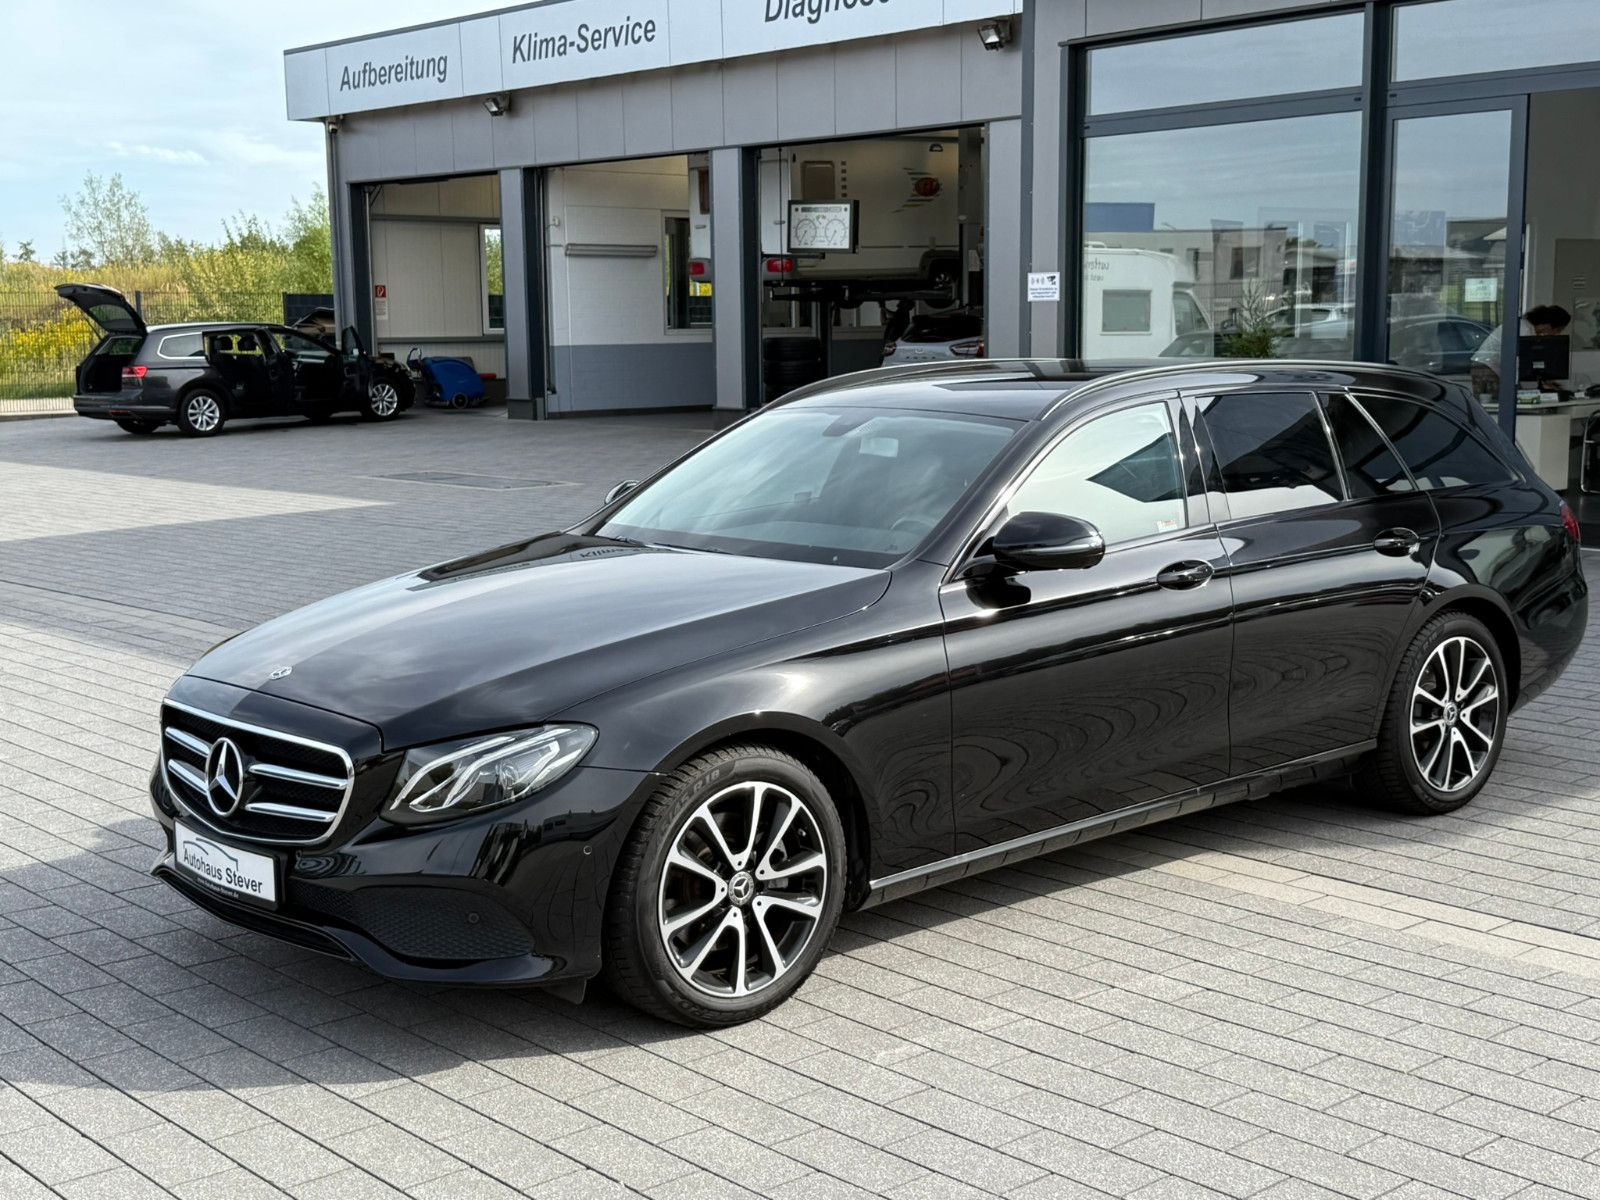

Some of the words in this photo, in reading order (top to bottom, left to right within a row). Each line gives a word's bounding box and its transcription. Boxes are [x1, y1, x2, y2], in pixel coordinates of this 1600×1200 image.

[765, 0, 889, 24] Diag
[512, 15, 656, 64] Klima-Service
[339, 55, 447, 91] Aufbereitung
[183, 848, 223, 881] Autohaus
[225, 868, 263, 893] Stever
